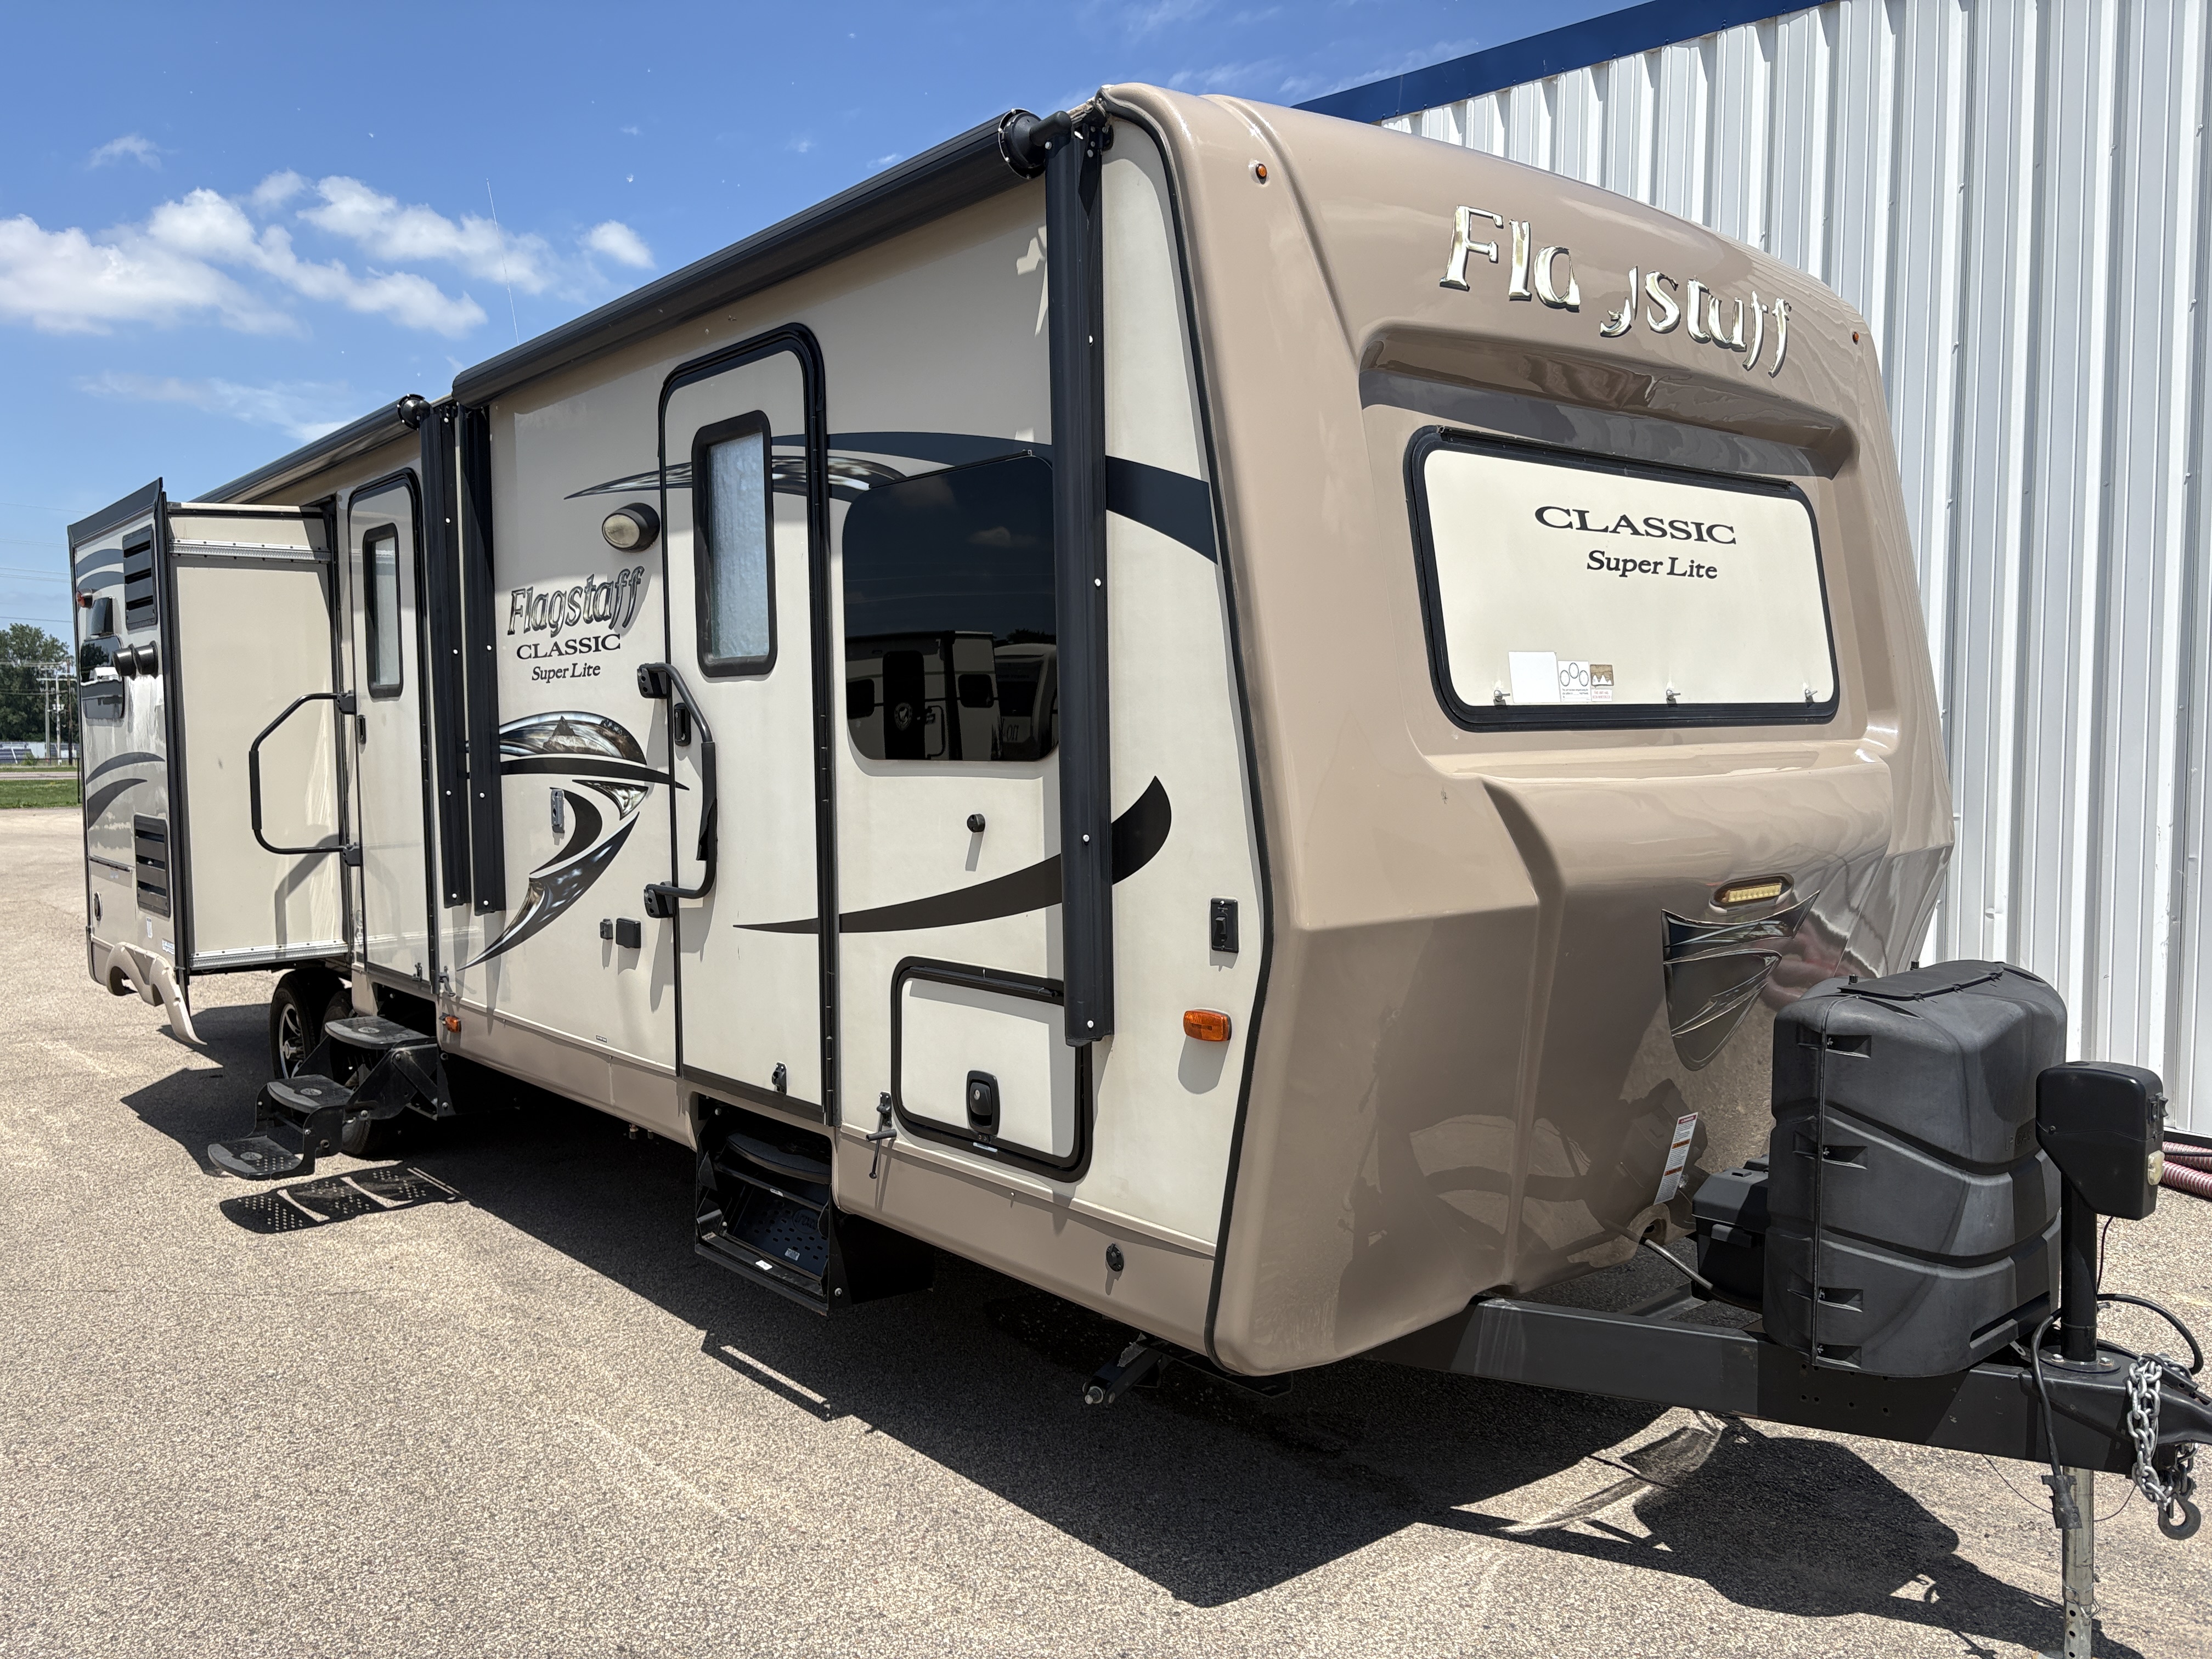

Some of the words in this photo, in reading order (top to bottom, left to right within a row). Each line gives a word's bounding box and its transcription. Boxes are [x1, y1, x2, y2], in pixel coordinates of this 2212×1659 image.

[1534, 506, 1736, 545] CLASSIC
[1587, 550, 1663, 578] Super
[1666, 556, 1718, 579] Lite
[507, 566, 645, 638] Flagstaff
[516, 633, 621, 660] CLASSIC
[532, 666, 569, 684] Super
[569, 662, 601, 678] Lite
